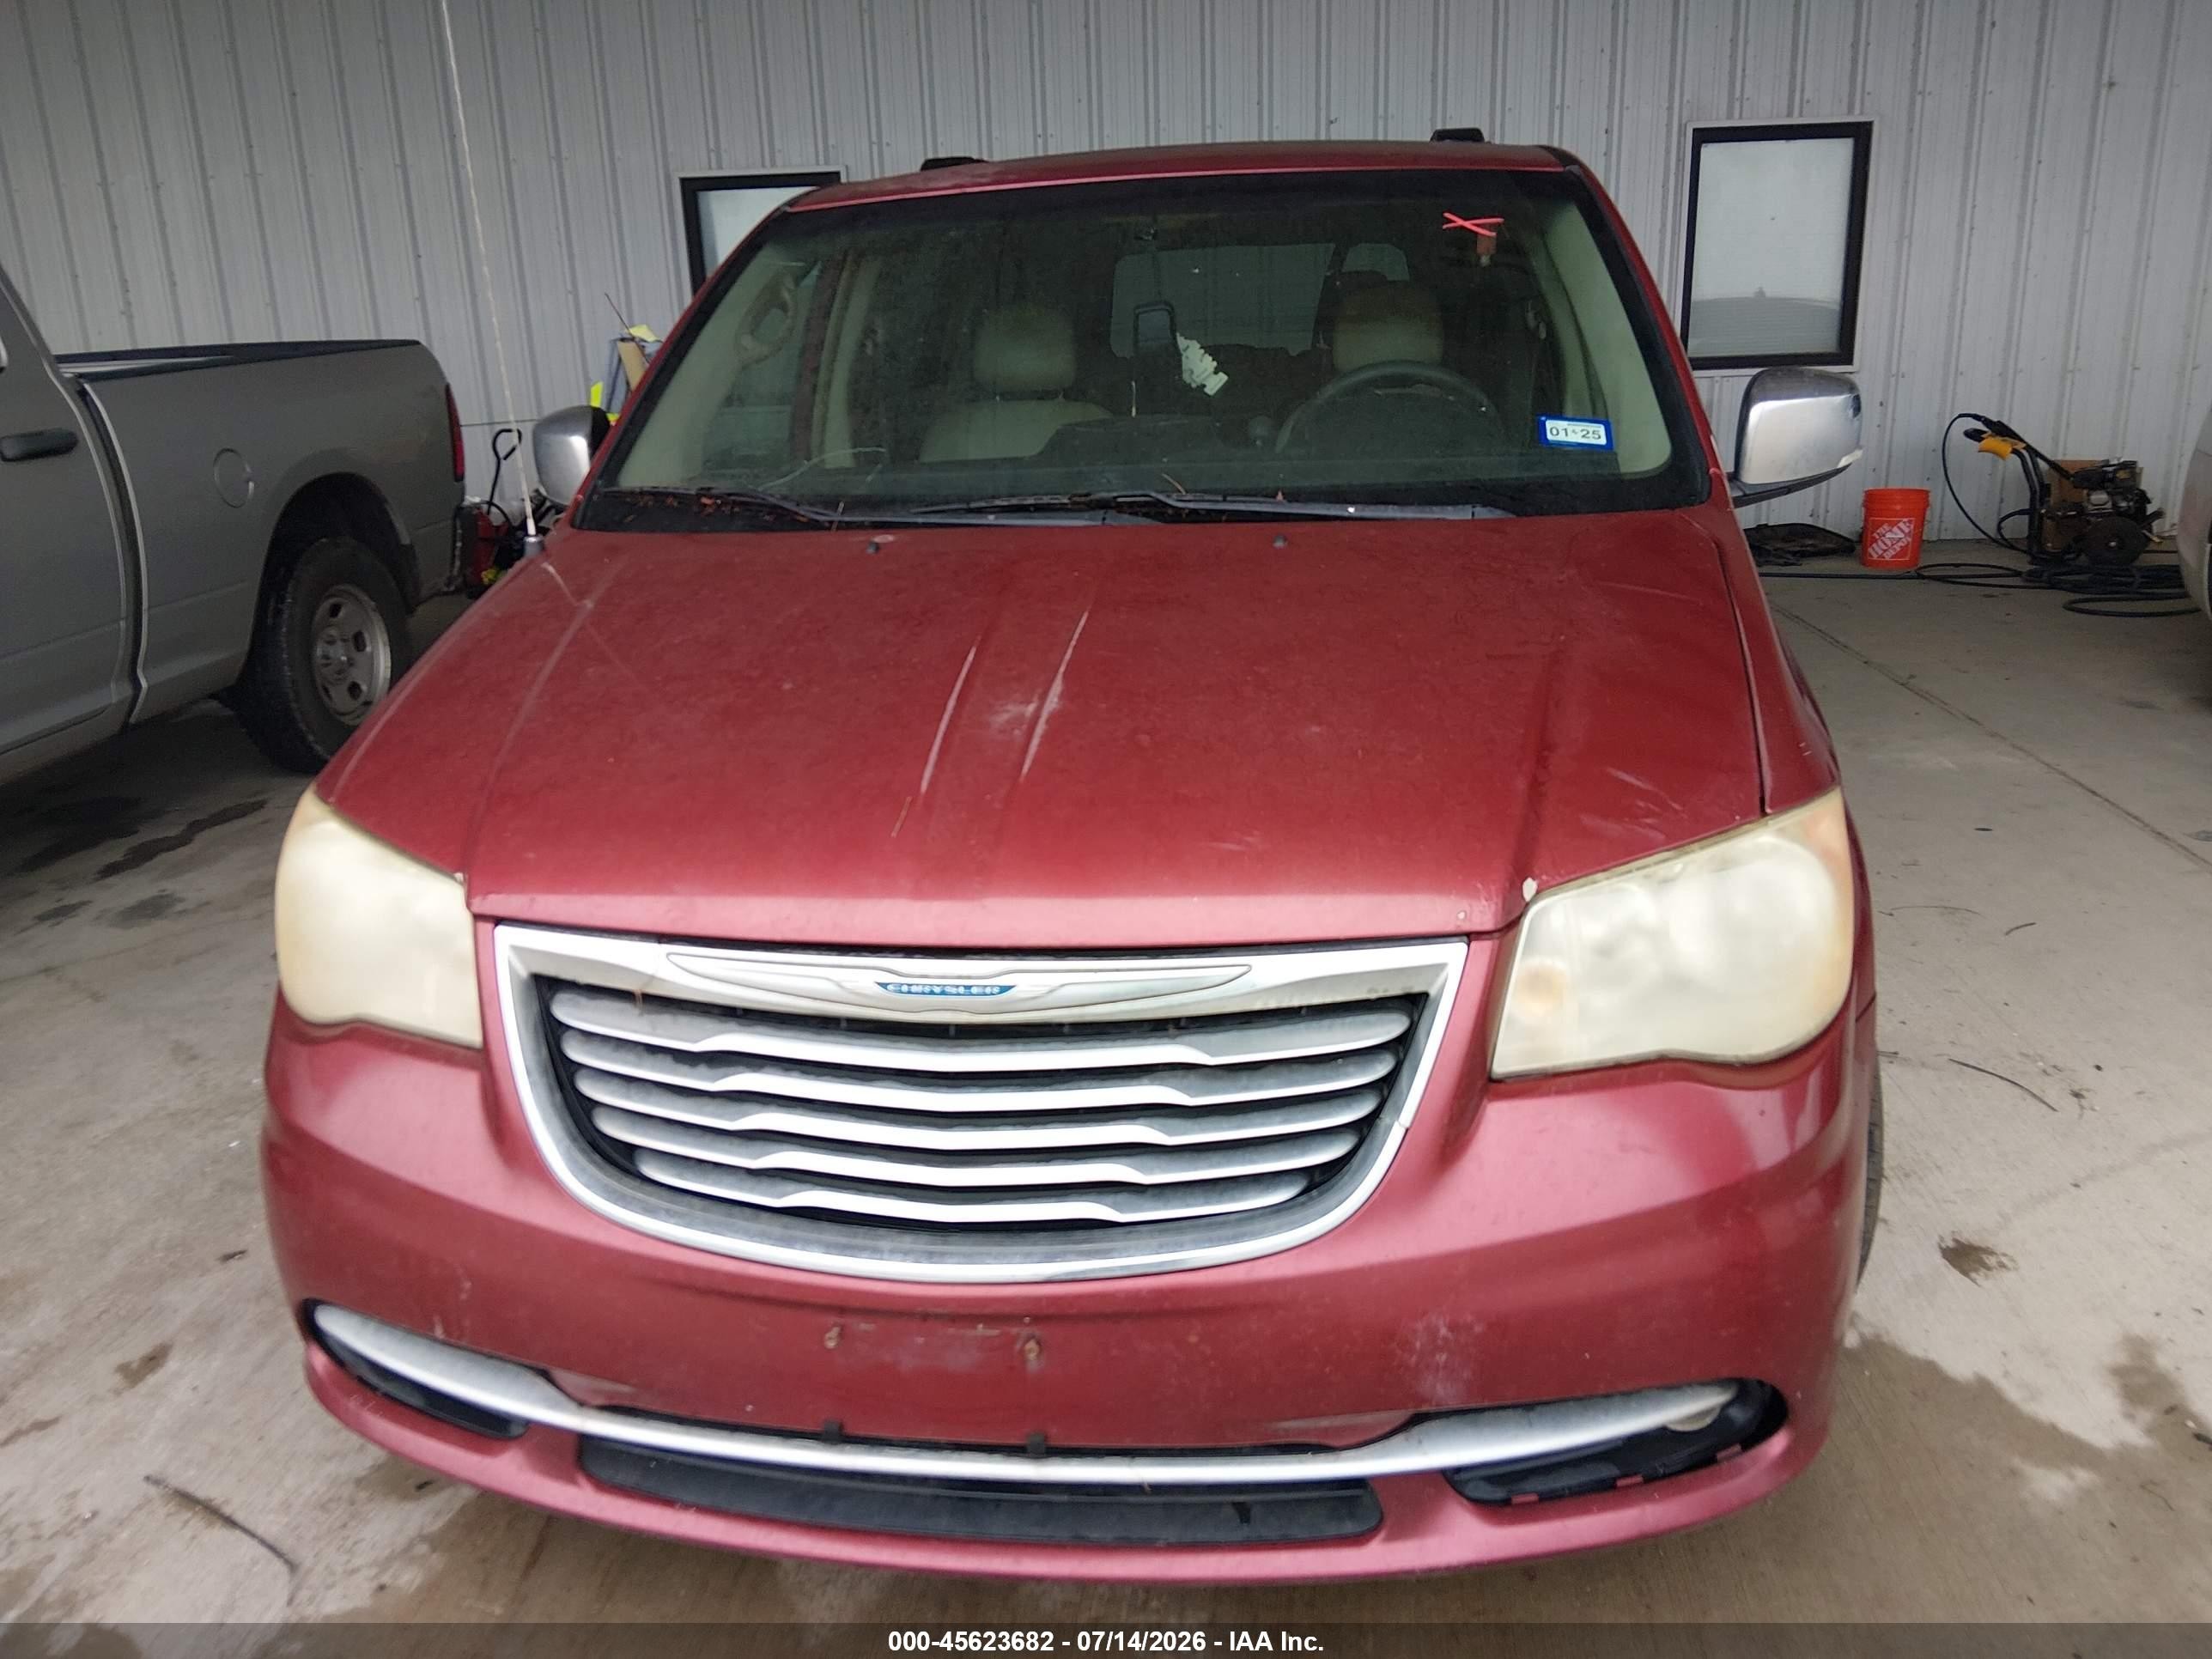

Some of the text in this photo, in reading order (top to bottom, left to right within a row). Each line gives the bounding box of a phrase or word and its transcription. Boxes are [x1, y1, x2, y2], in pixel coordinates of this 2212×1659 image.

[1549, 426, 1601, 440] 01 25
[1868, 518, 1914, 559] HOME
